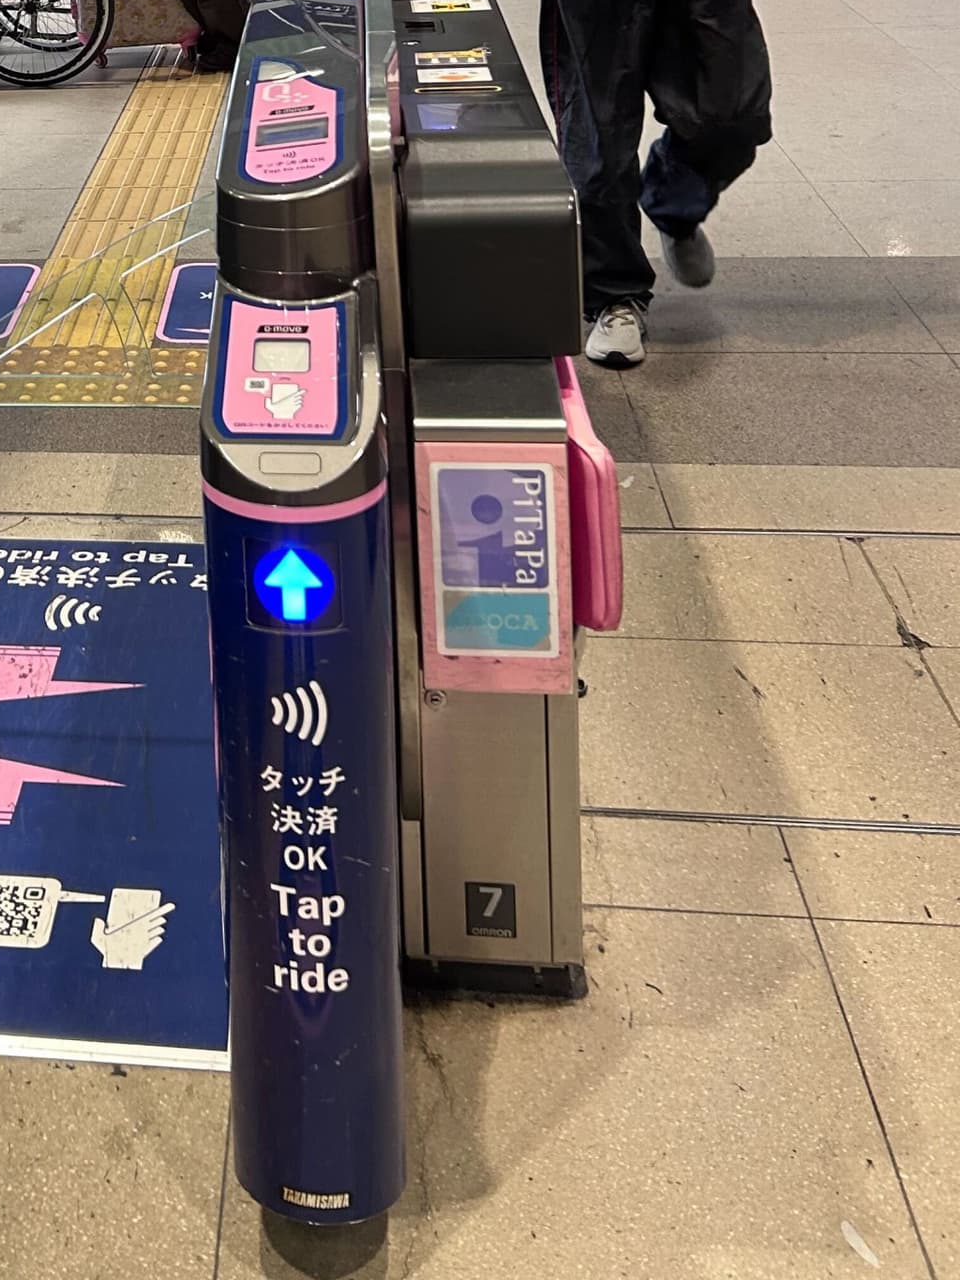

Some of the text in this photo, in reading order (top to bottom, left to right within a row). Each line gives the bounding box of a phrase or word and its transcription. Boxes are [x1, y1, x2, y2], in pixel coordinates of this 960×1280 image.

[511, 474, 545, 585] PiTaPa
[71, 550, 113, 563] to
[121, 549, 194, 567] Tap
[260, 765, 346, 797] タッチ
[270, 803, 338, 836] 決済
[283, 844, 328, 872] OK
[270, 882, 346, 926] Tap
[478, 886, 503, 918] 7
[289, 927, 332, 958] to
[273, 961, 351, 994] ride
[283, 1187, 350, 1210] TAKAMISAWA
